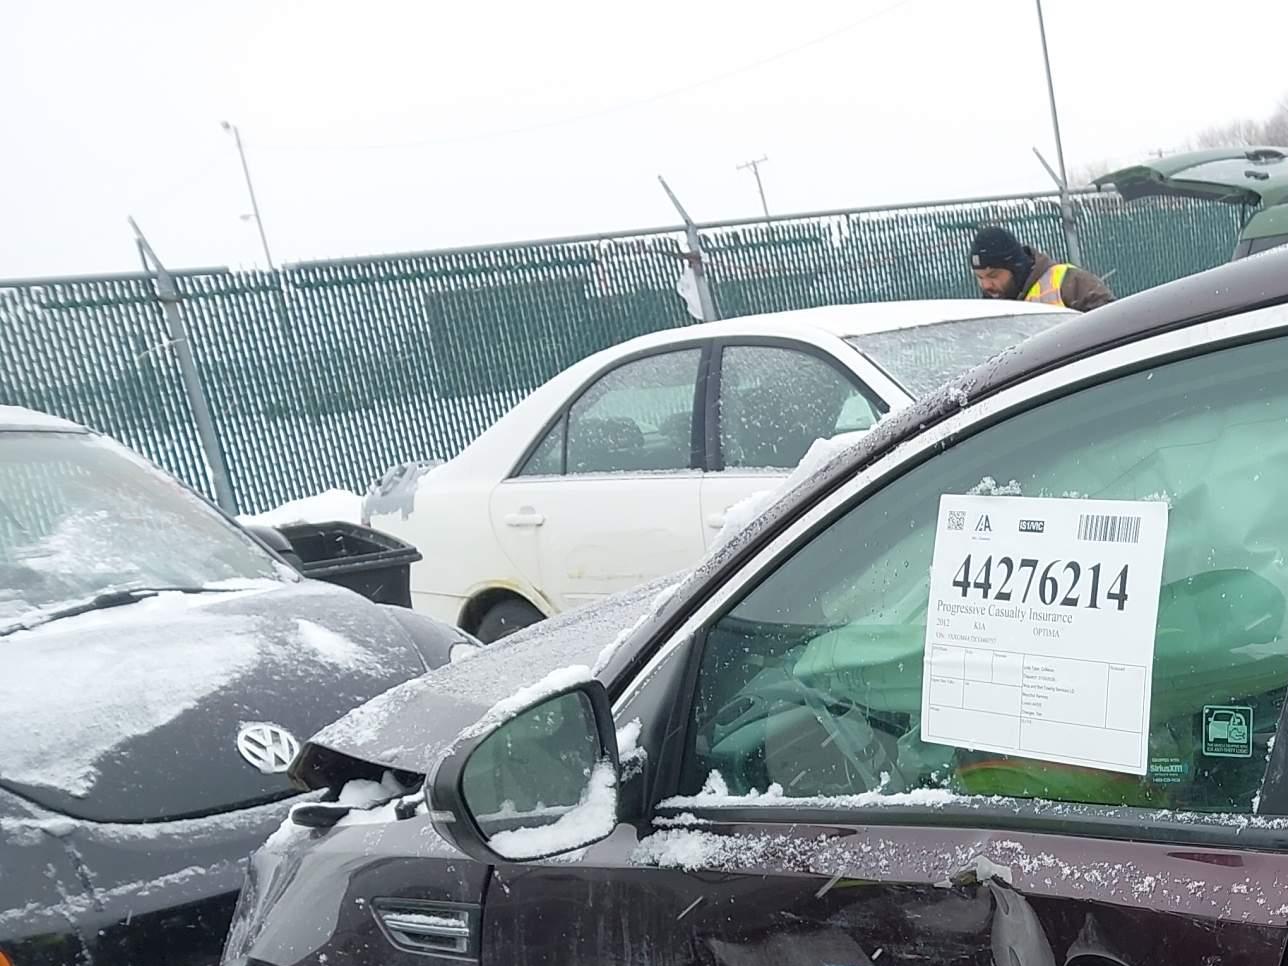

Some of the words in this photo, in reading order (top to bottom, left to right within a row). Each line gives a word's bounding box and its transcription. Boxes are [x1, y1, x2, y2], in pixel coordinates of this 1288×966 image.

[952, 553, 1128, 611] 44276214
[937, 600, 985, 615] Progressive
[988, 604, 1025, 622] Casualty
[1029, 607, 1073, 624] Insurance
[973, 621, 986, 631] KIA
[1032, 626, 1060, 638] OPTIMA
